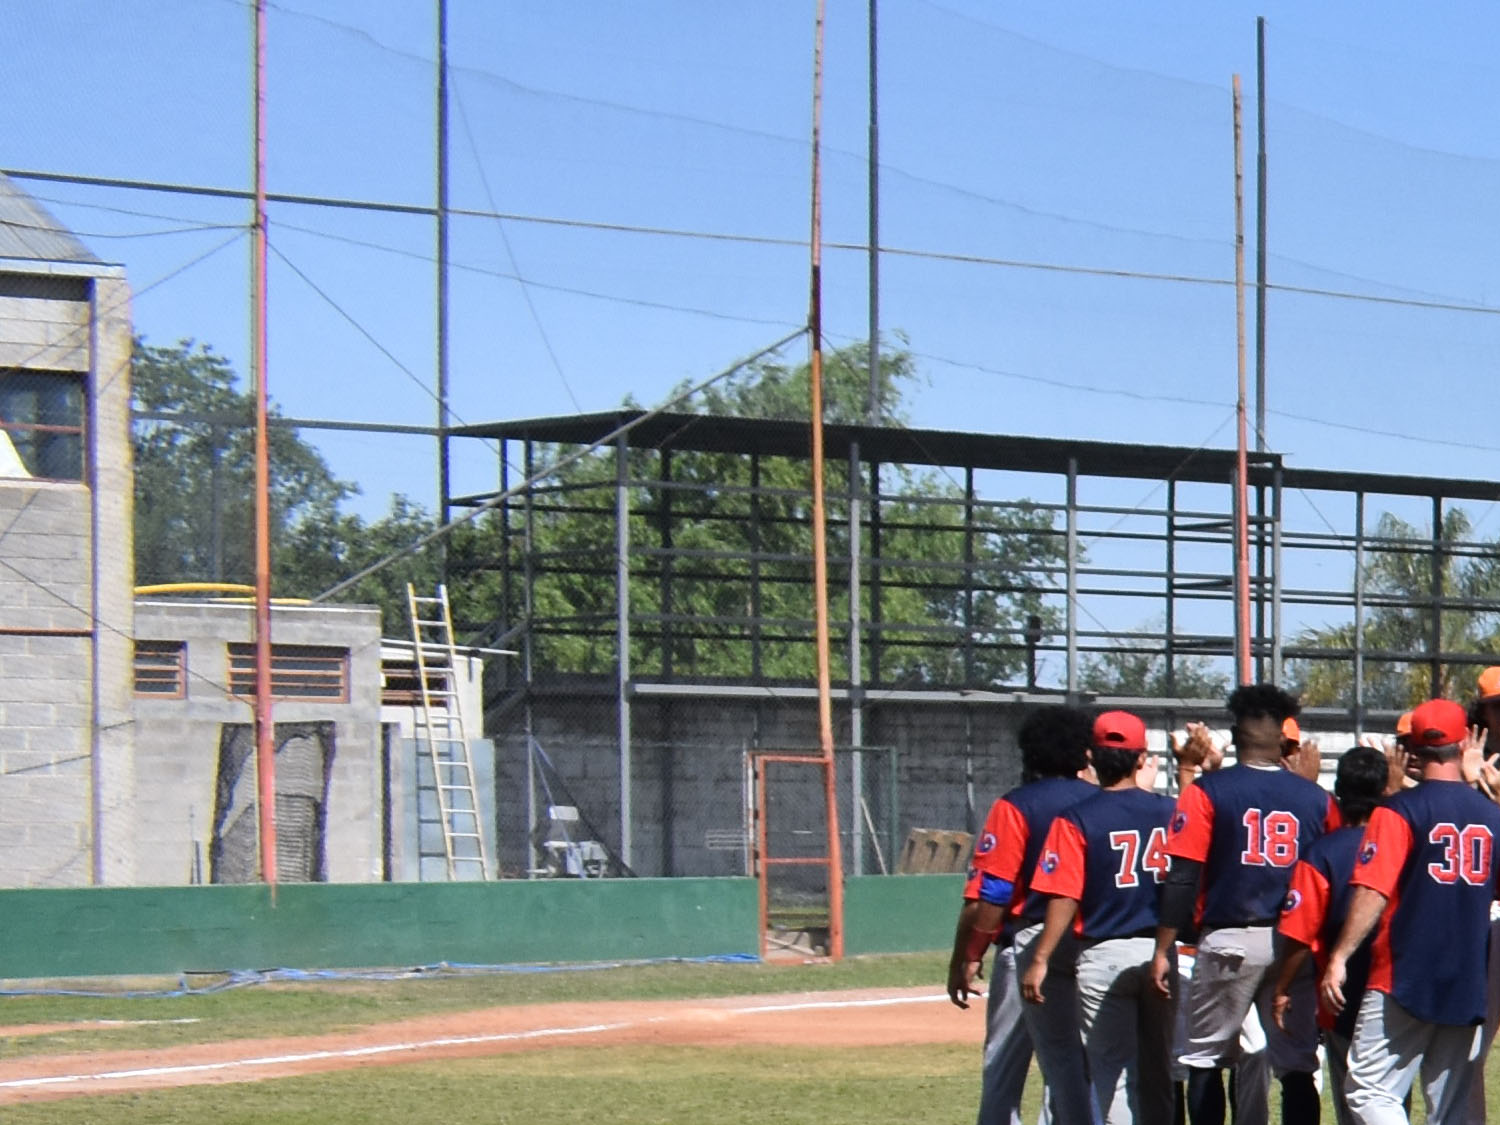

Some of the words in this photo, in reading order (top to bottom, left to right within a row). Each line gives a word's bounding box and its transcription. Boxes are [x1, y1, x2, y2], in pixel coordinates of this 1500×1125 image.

[1109, 827, 1171, 888] 74
[1241, 808, 1300, 868] 18
[1428, 822, 1494, 887] 30
